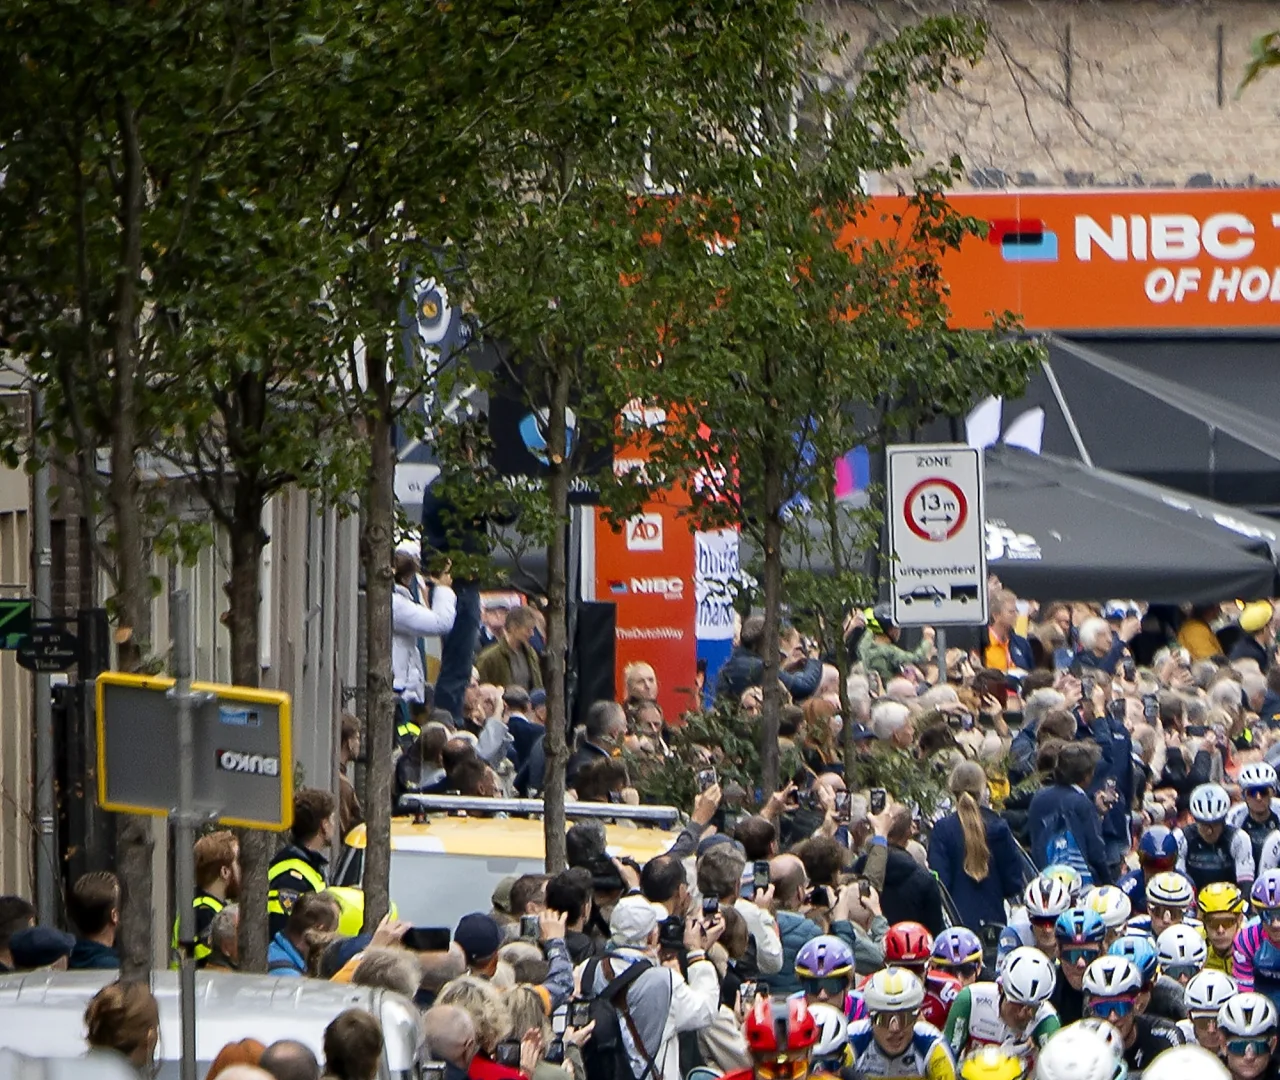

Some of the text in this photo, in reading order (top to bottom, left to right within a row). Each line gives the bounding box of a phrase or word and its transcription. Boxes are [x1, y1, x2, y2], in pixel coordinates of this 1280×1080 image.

[1074, 211, 1256, 261] NIBC
[1144, 267, 1201, 303] OF
[916, 456, 952, 468] ZONE
[631, 524, 659, 541] AD
[900, 565, 976, 579] uitgezonderd
[630, 577, 684, 595] NIBC
